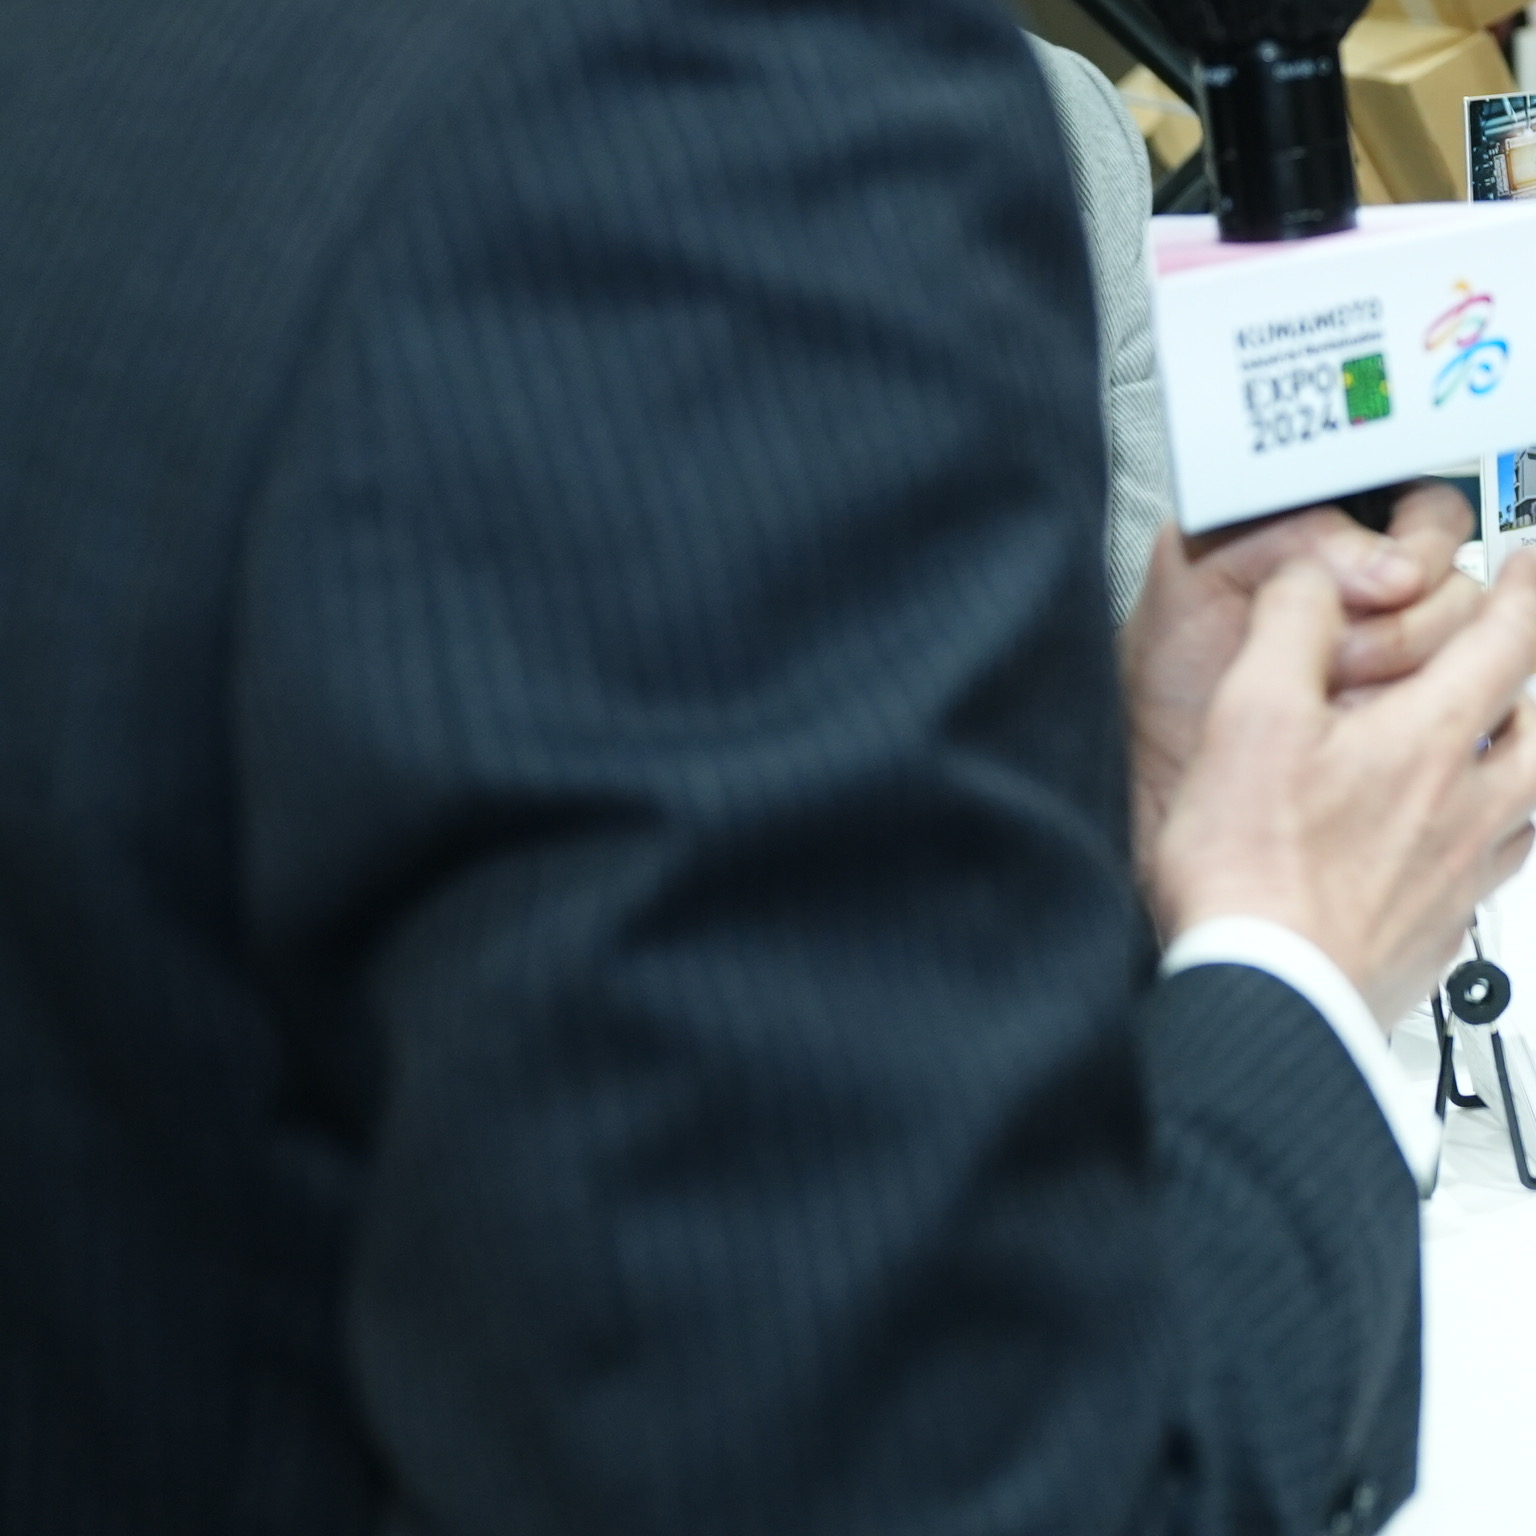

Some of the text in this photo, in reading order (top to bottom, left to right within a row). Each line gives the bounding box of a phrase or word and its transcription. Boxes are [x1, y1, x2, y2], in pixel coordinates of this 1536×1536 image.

[1236, 297, 1383, 350] KUMAMOTO
[1244, 363, 1336, 409] EXPO
[1250, 404, 1340, 454] 2024
